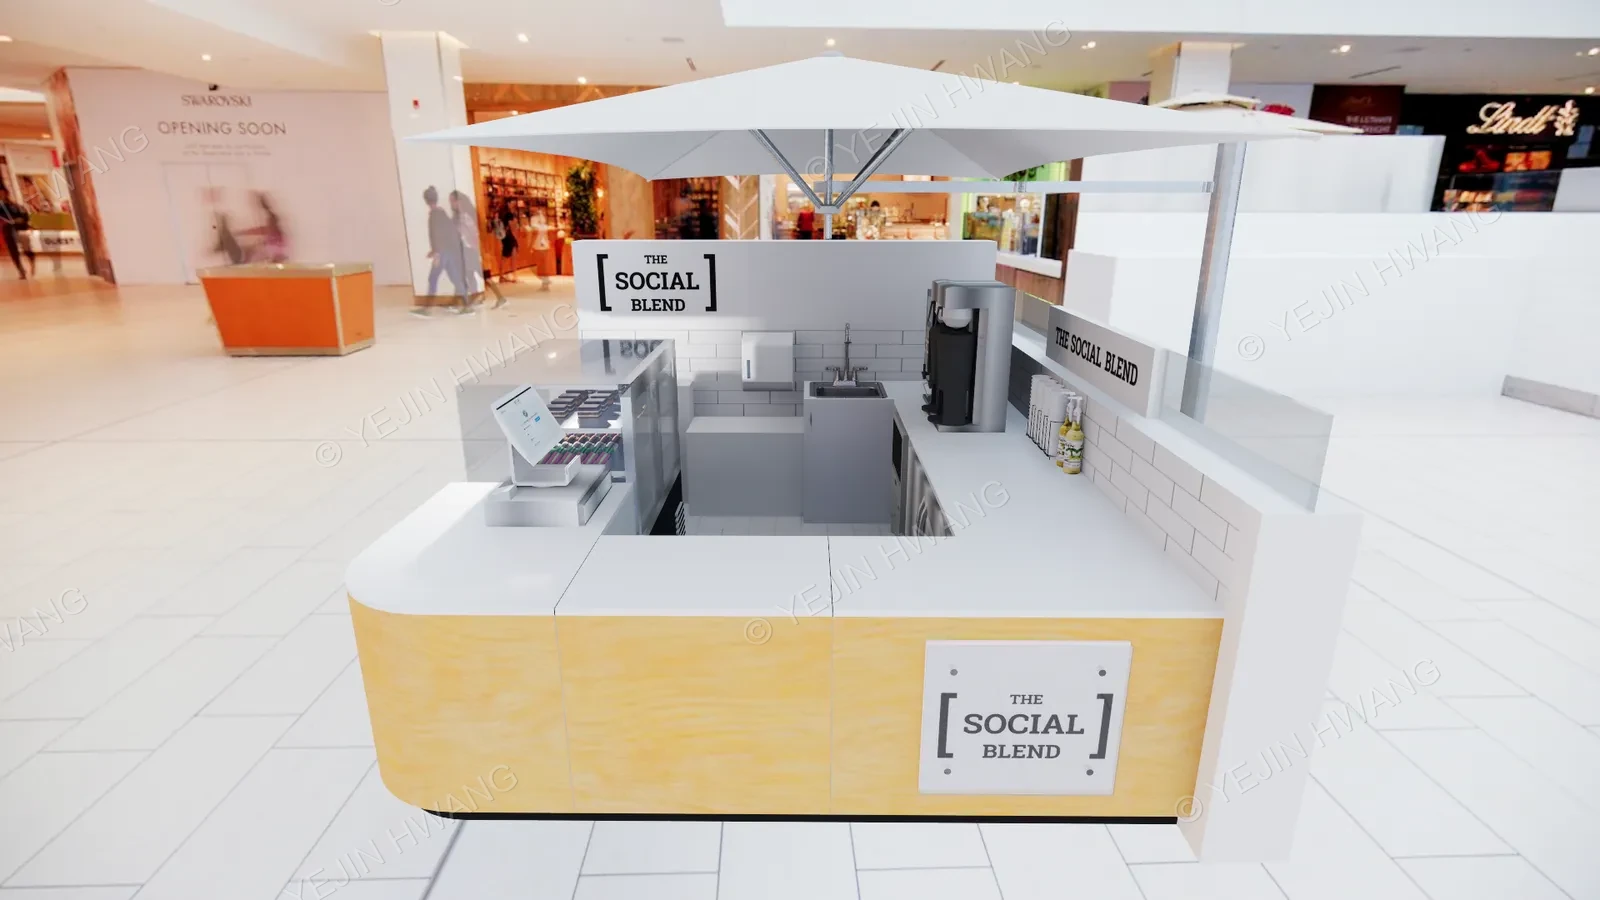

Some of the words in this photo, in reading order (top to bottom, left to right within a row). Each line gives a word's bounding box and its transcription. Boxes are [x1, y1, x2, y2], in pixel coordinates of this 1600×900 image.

[1466, 101, 1560, 135] Lindt
[157, 121, 232, 135] OPENING
[238, 121, 287, 135] SOON
[644, 254, 668, 264] THE
[615, 271, 700, 290] SOCIAL
[631, 298, 686, 312] BLEND
[1055, 326, 1070, 350] THE
[1070, 334, 1102, 368] SOCIAL
[1104, 350, 1138, 386] BLEND
[1010, 694, 1043, 705] THE
[963, 713, 1085, 735] SOCIAL
[982, 744, 1061, 759] BLEND
